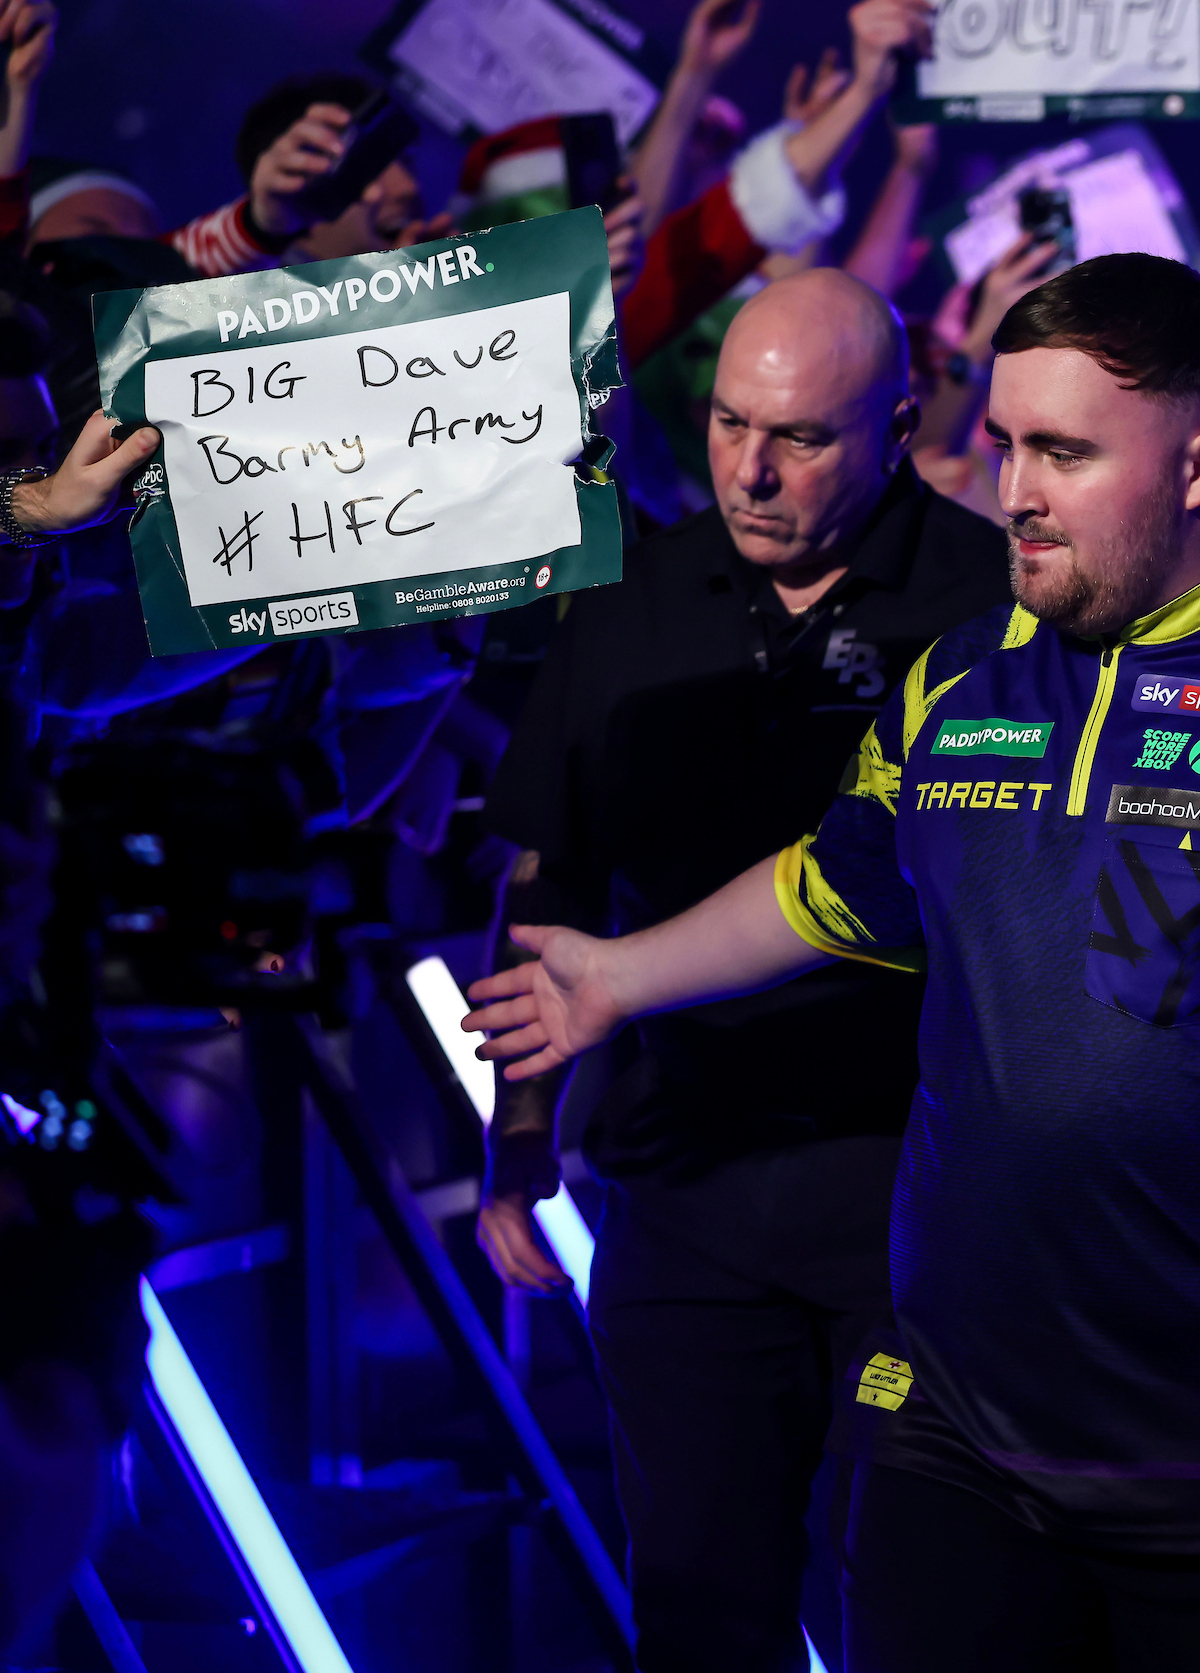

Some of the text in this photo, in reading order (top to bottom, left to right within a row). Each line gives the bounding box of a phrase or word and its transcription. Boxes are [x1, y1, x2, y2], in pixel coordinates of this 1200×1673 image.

[190, 329, 518, 417] BIG Dave
[197, 404, 543, 485] Barmy Army
[415, 591, 510, 614] Helpline: 0808 8020133
[228, 600, 351, 636] sky sports
[822, 629, 886, 698] EPS
[1139, 682, 1181, 707] sky
[1142, 728, 1193, 744] SCORE
[1143, 738, 1187, 753] MORE
[1132, 757, 1174, 771] XBOX
[1141, 748, 1181, 762] WITH
[916, 781, 1053, 811] TARGET
